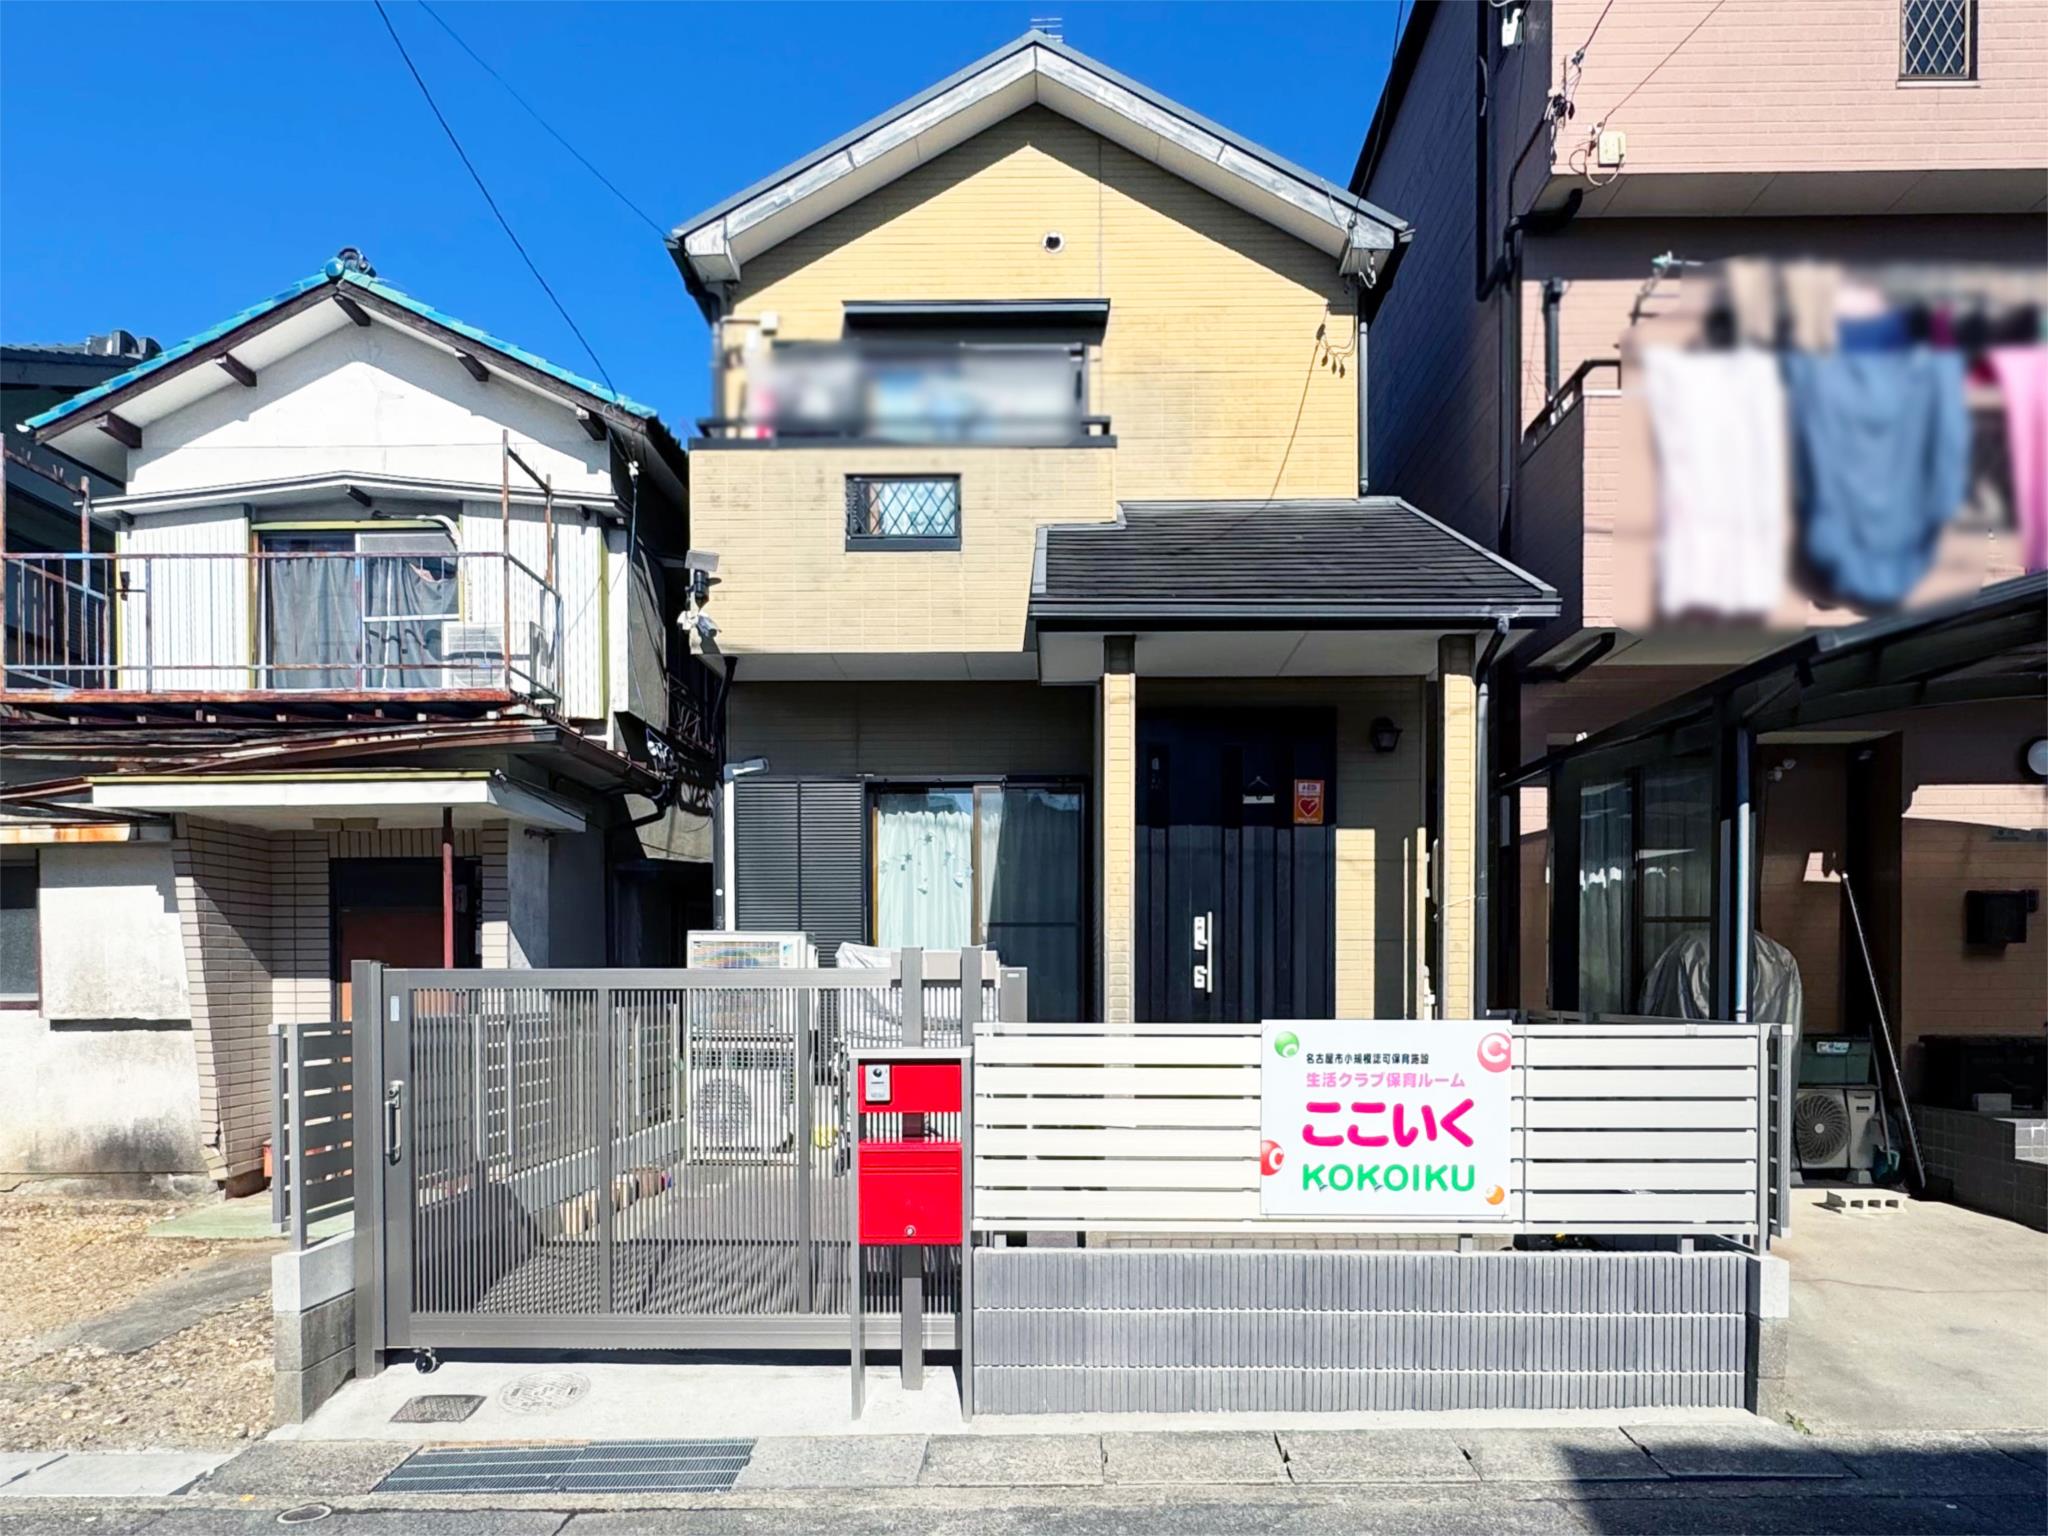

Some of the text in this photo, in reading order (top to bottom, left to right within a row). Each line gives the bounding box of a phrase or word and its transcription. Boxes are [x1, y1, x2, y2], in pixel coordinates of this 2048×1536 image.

[1306, 1053, 1429, 1065] 名古屋市小規模認可保育施設
[1306, 1072, 1465, 1088] 生活クラブ保育ルーム
[1302, 1098, 1474, 1148] ここいく
[1302, 1163, 1475, 1192] KOKOIKU
